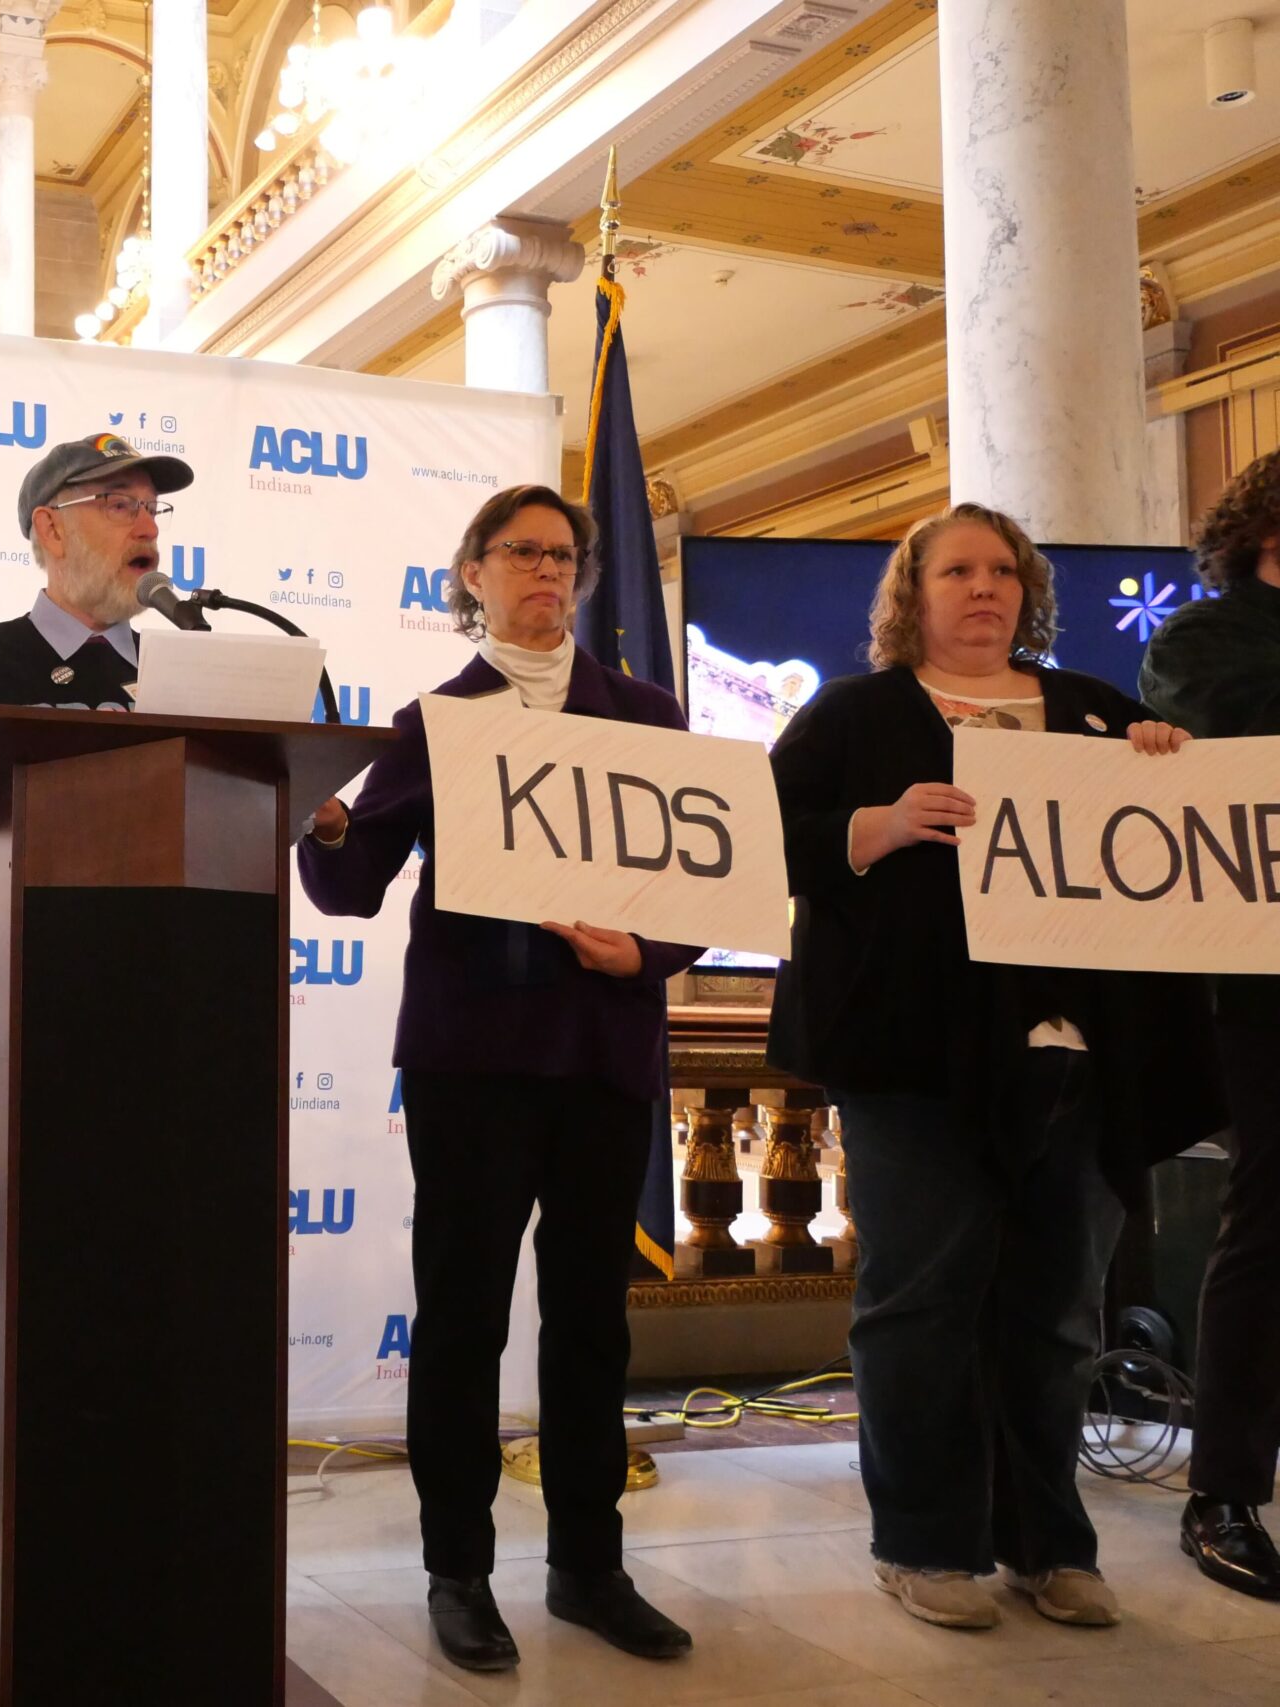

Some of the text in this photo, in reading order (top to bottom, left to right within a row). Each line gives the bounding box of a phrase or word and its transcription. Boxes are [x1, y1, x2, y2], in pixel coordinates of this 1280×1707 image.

[249, 425, 368, 480] ACLU
[249, 474, 313, 496] Indiana
[411, 465, 499, 487] www.aclu-in.org
[269, 590, 352, 609] @ACLUindiana
[495, 754, 733, 879] KIDS
[979, 797, 1280, 904] ALONE
